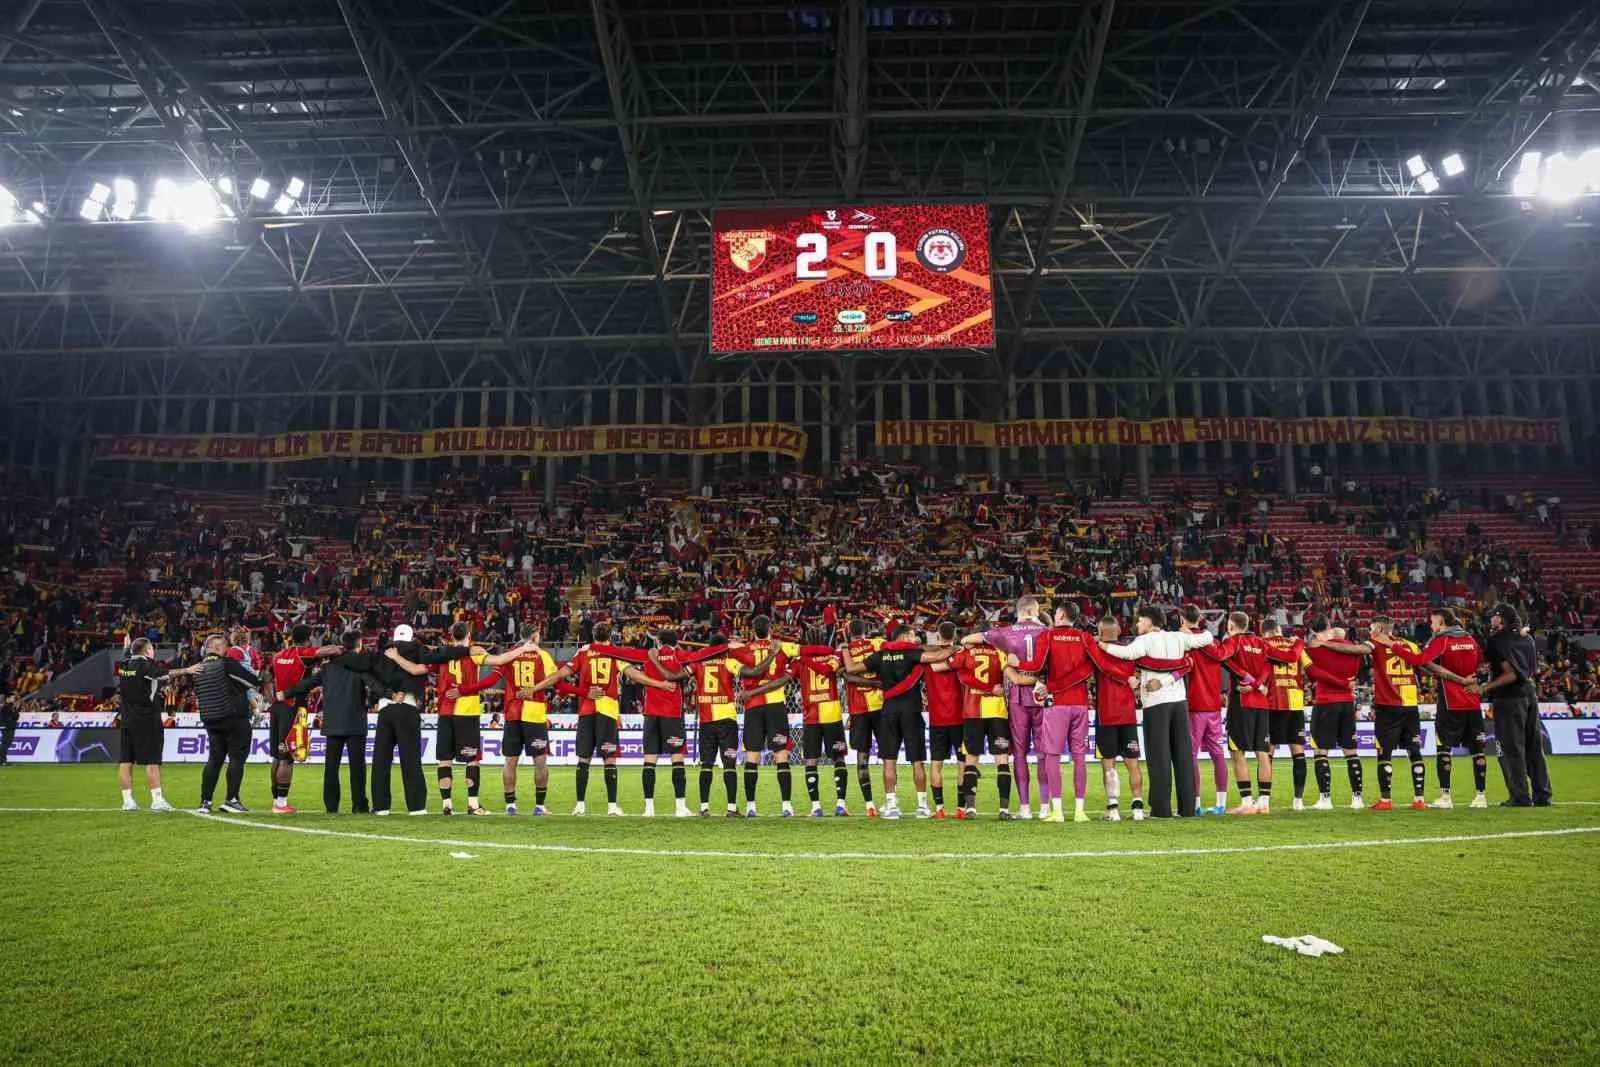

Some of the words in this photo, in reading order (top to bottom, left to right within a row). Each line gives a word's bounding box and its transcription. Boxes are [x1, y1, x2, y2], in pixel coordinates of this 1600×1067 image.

[796, 233, 828, 278] 2
[864, 232, 897, 277] 0
[321, 432, 353, 454] VE
[359, 432, 424, 454] SPOR
[880, 421, 984, 446] KUTSAL
[994, 420, 1109, 446] ARMAYA
[1117, 418, 1184, 445] OLAN
[1023, 634, 1034, 662] 1
[512, 660, 535, 688] 18
[589, 658, 611, 684] 19
[704, 666, 719, 693] 6
[974, 655, 990, 684] 2
